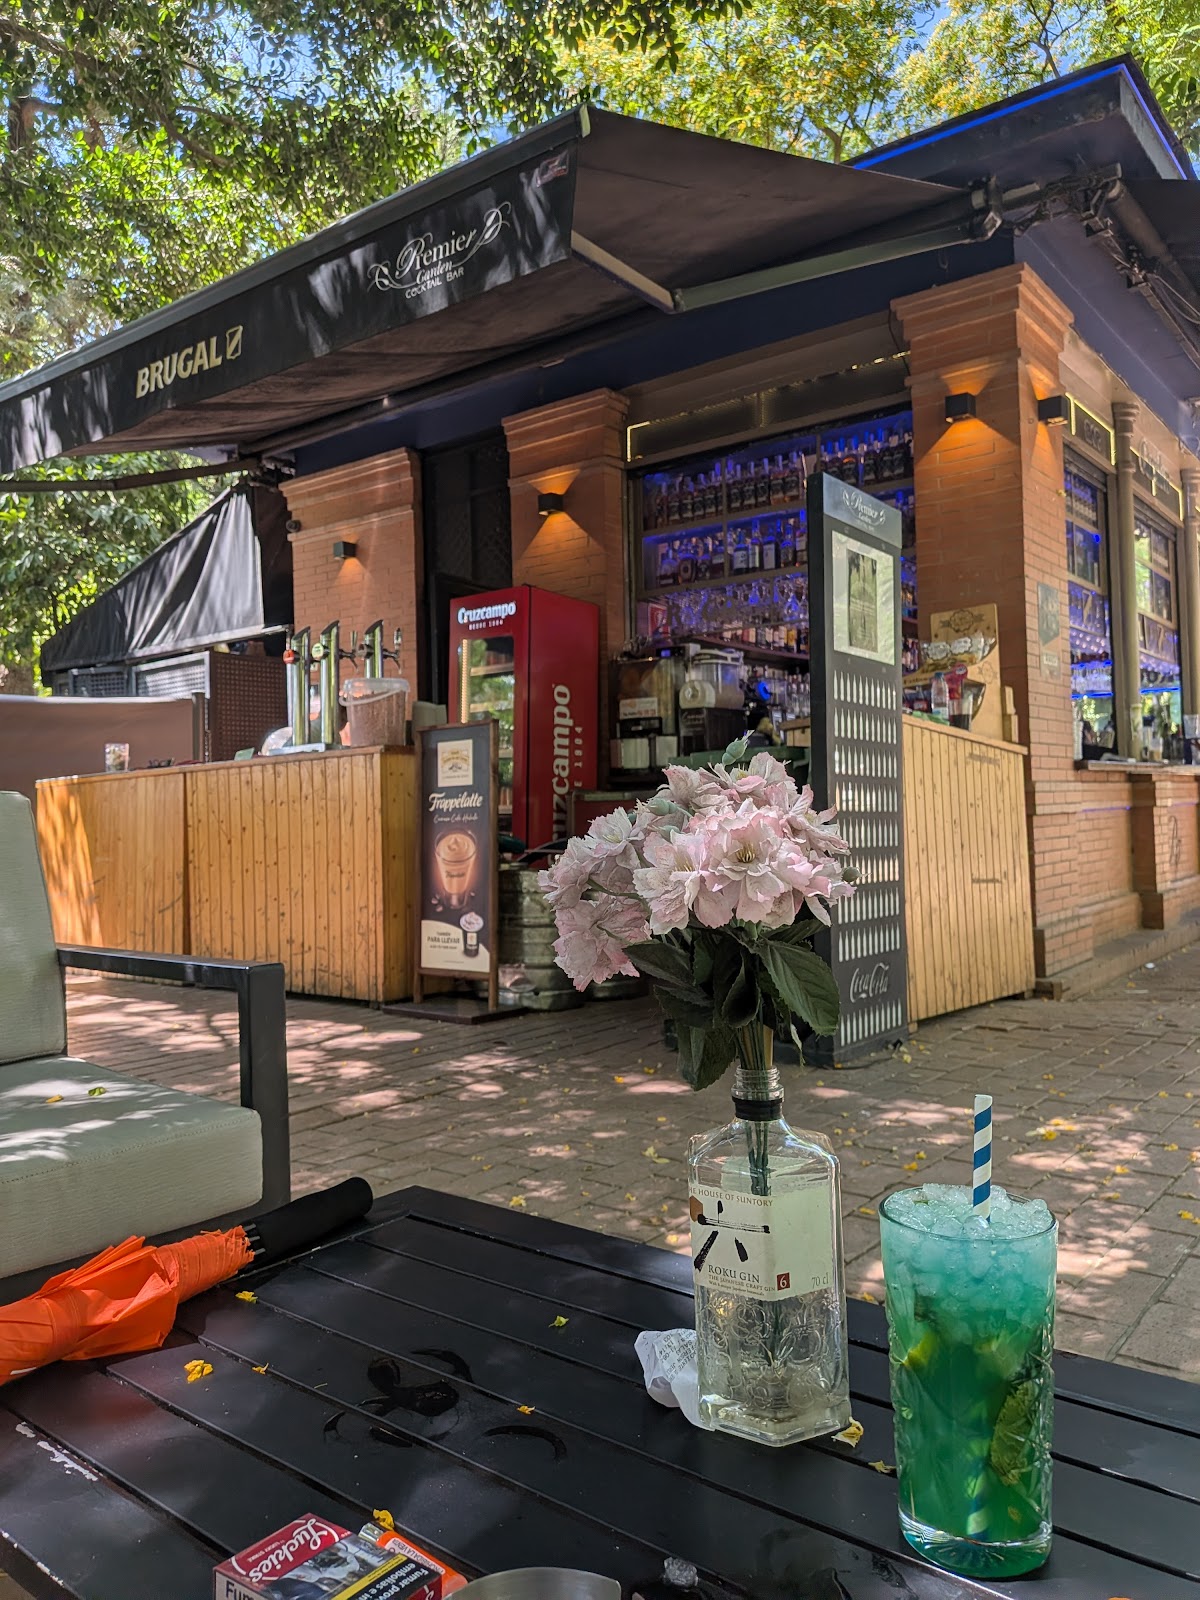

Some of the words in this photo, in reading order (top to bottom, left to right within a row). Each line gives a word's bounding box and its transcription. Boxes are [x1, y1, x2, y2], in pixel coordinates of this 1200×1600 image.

[396, 228, 477, 280] Premier
[405, 279, 442, 299] COCKTAIL
[446, 267, 465, 282] BAR
[415, 260, 453, 285] Garden
[135, 336, 222, 399] BRUGAL
[457, 602, 516, 624] Cruzcampo
[698, 1189, 722, 1200] HOUSE
[736, 1196, 773, 1208] SUNTORY
[708, 1264, 737, 1279] ROKU
[739, 1271, 760, 1284] GIN
[811, 1275, 821, 1289] 70
[822, 1272, 829, 1286] cl
[745, 1282, 763, 1291] CRAFT
[248, 1518, 328, 1582] Luckies
[375, 1562, 416, 1590] embolias
[399, 1568, 429, 1588] Fumar
